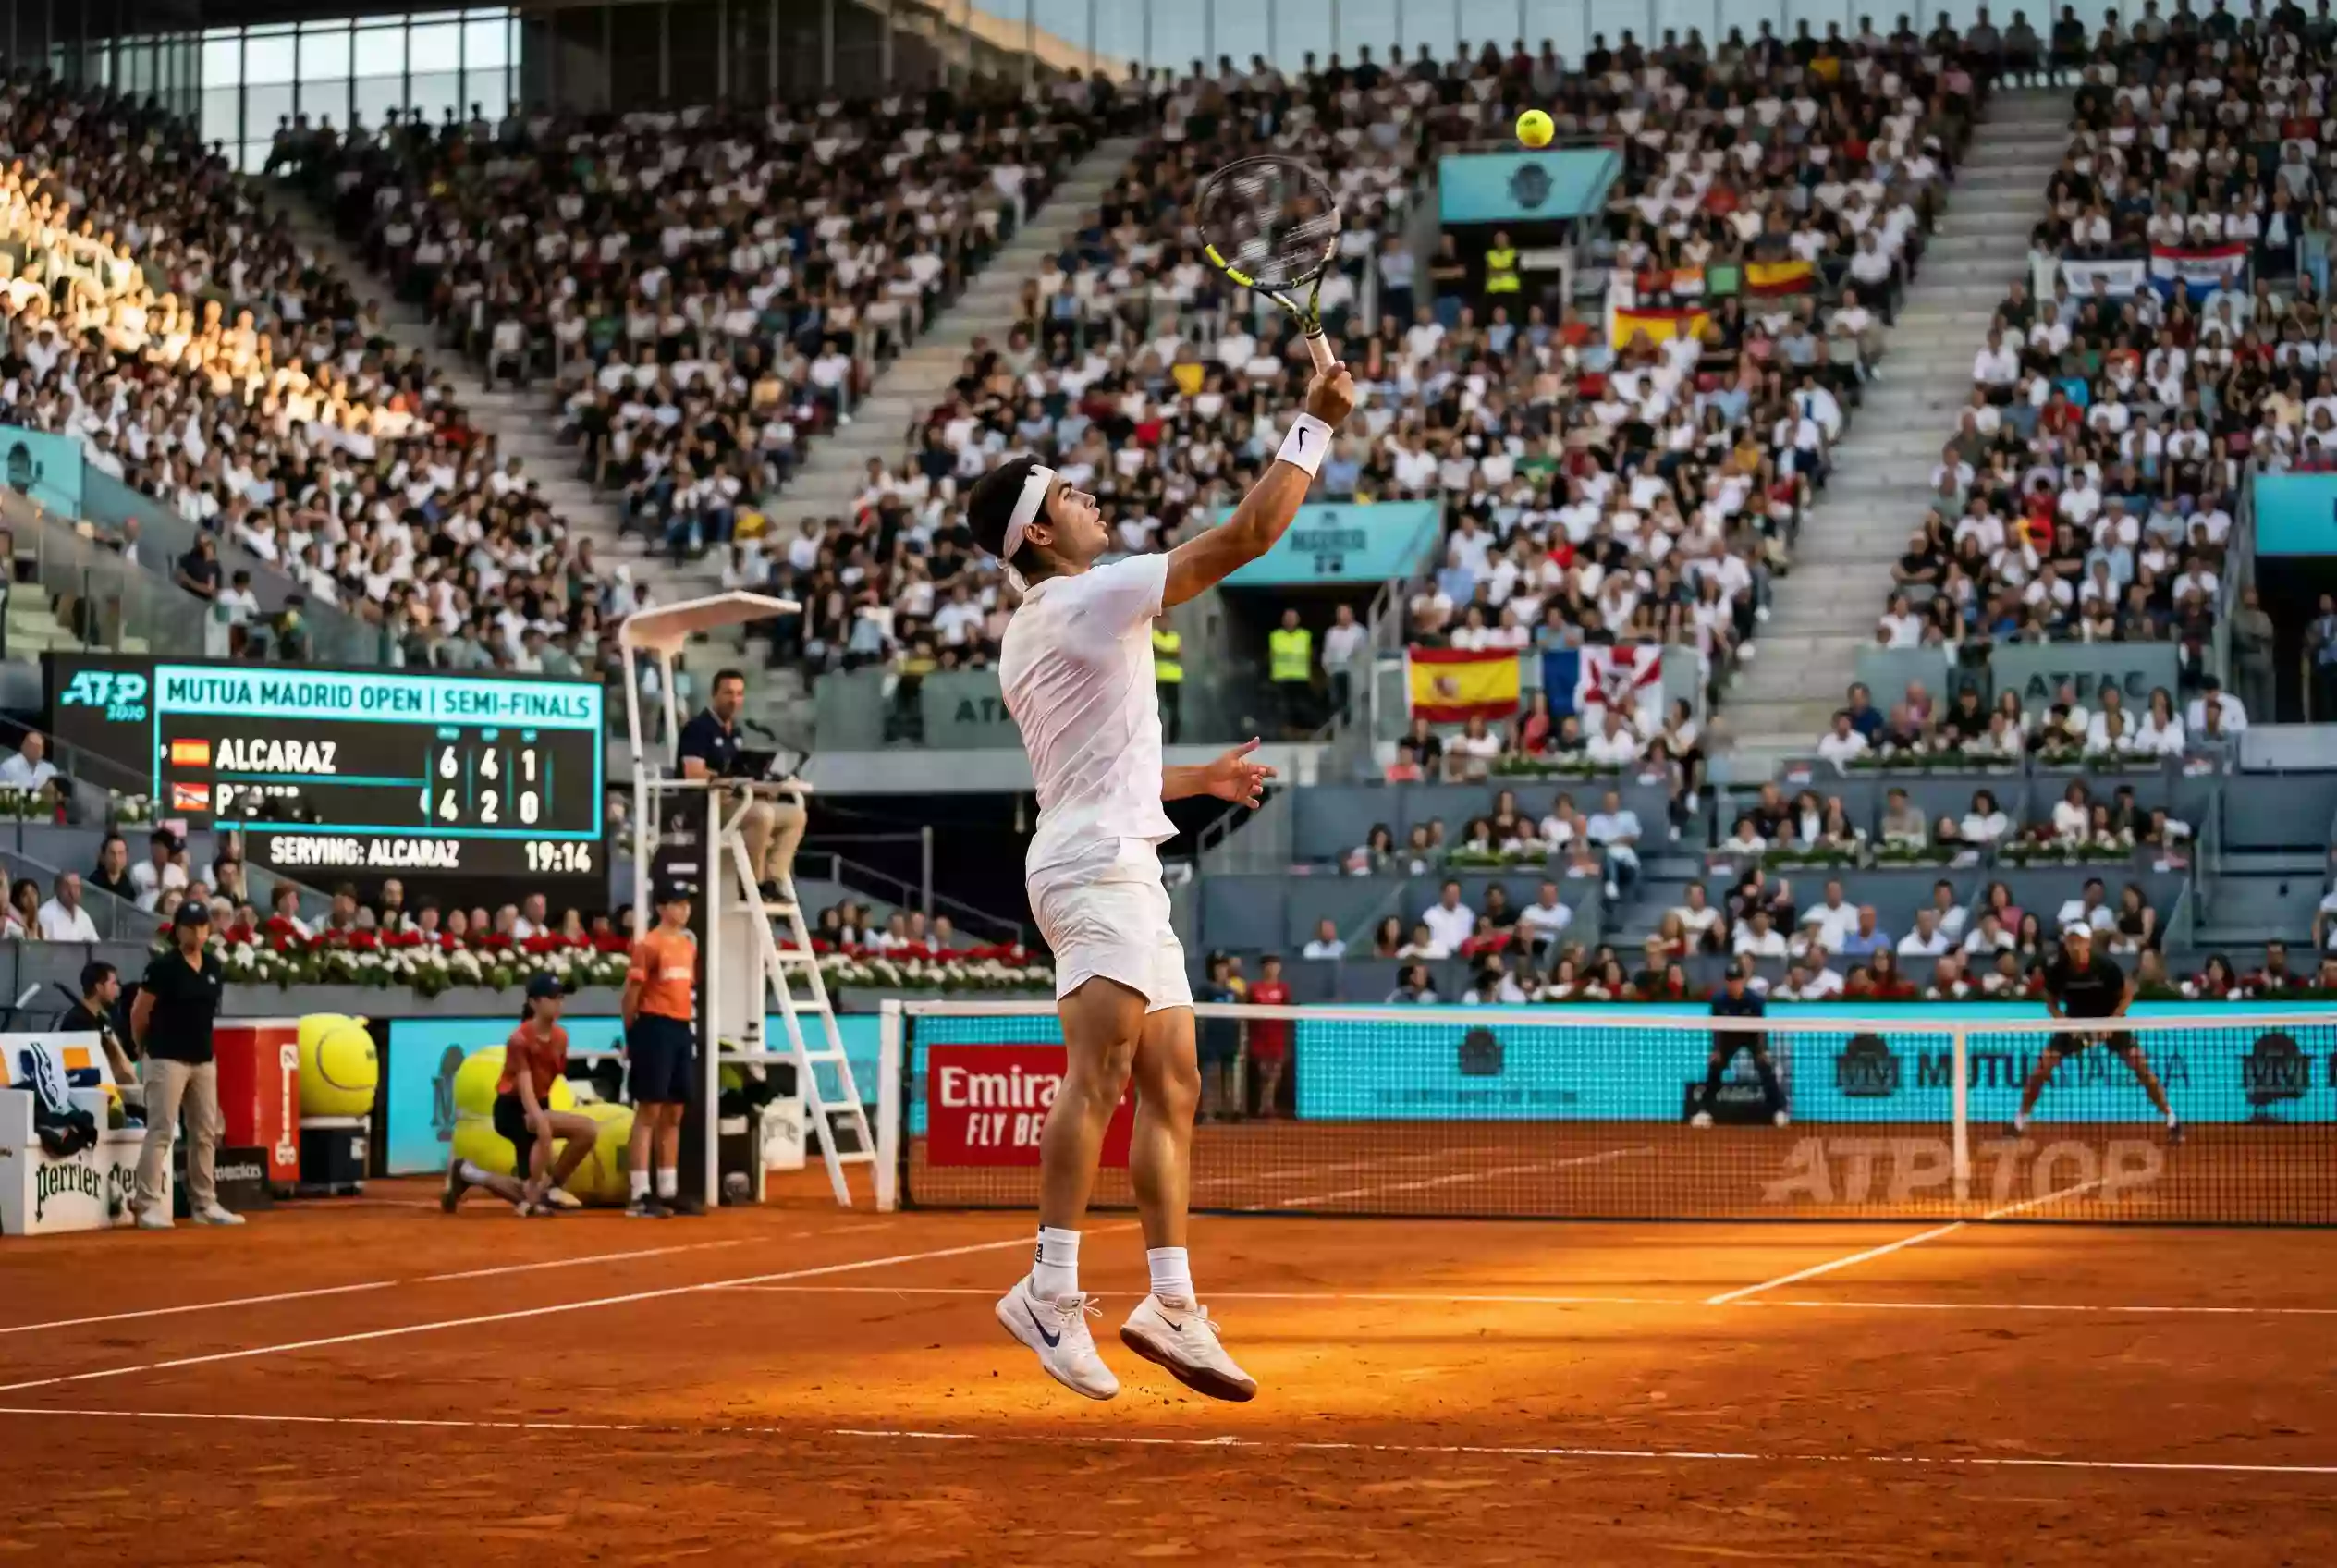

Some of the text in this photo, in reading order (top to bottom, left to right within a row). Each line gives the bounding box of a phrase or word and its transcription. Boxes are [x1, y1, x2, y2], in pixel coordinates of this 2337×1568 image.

[61, 671, 147, 705] ATP
[167, 677, 253, 704] MUTUA
[260, 683, 353, 708] MADRID
[360, 686, 422, 711] OPEN
[444, 691, 590, 718] SEMI-FINALS
[215, 738, 536, 781] ALCARAZ 6 4 1
[439, 788, 539, 824] 4 2 0
[270, 835, 592, 873] SERVING: ALCARAZ 19:14
[939, 1065, 1066, 1108] Emira
[965, 1112, 1007, 1146] FLY
[1760, 1136, 1952, 1202] ATP
